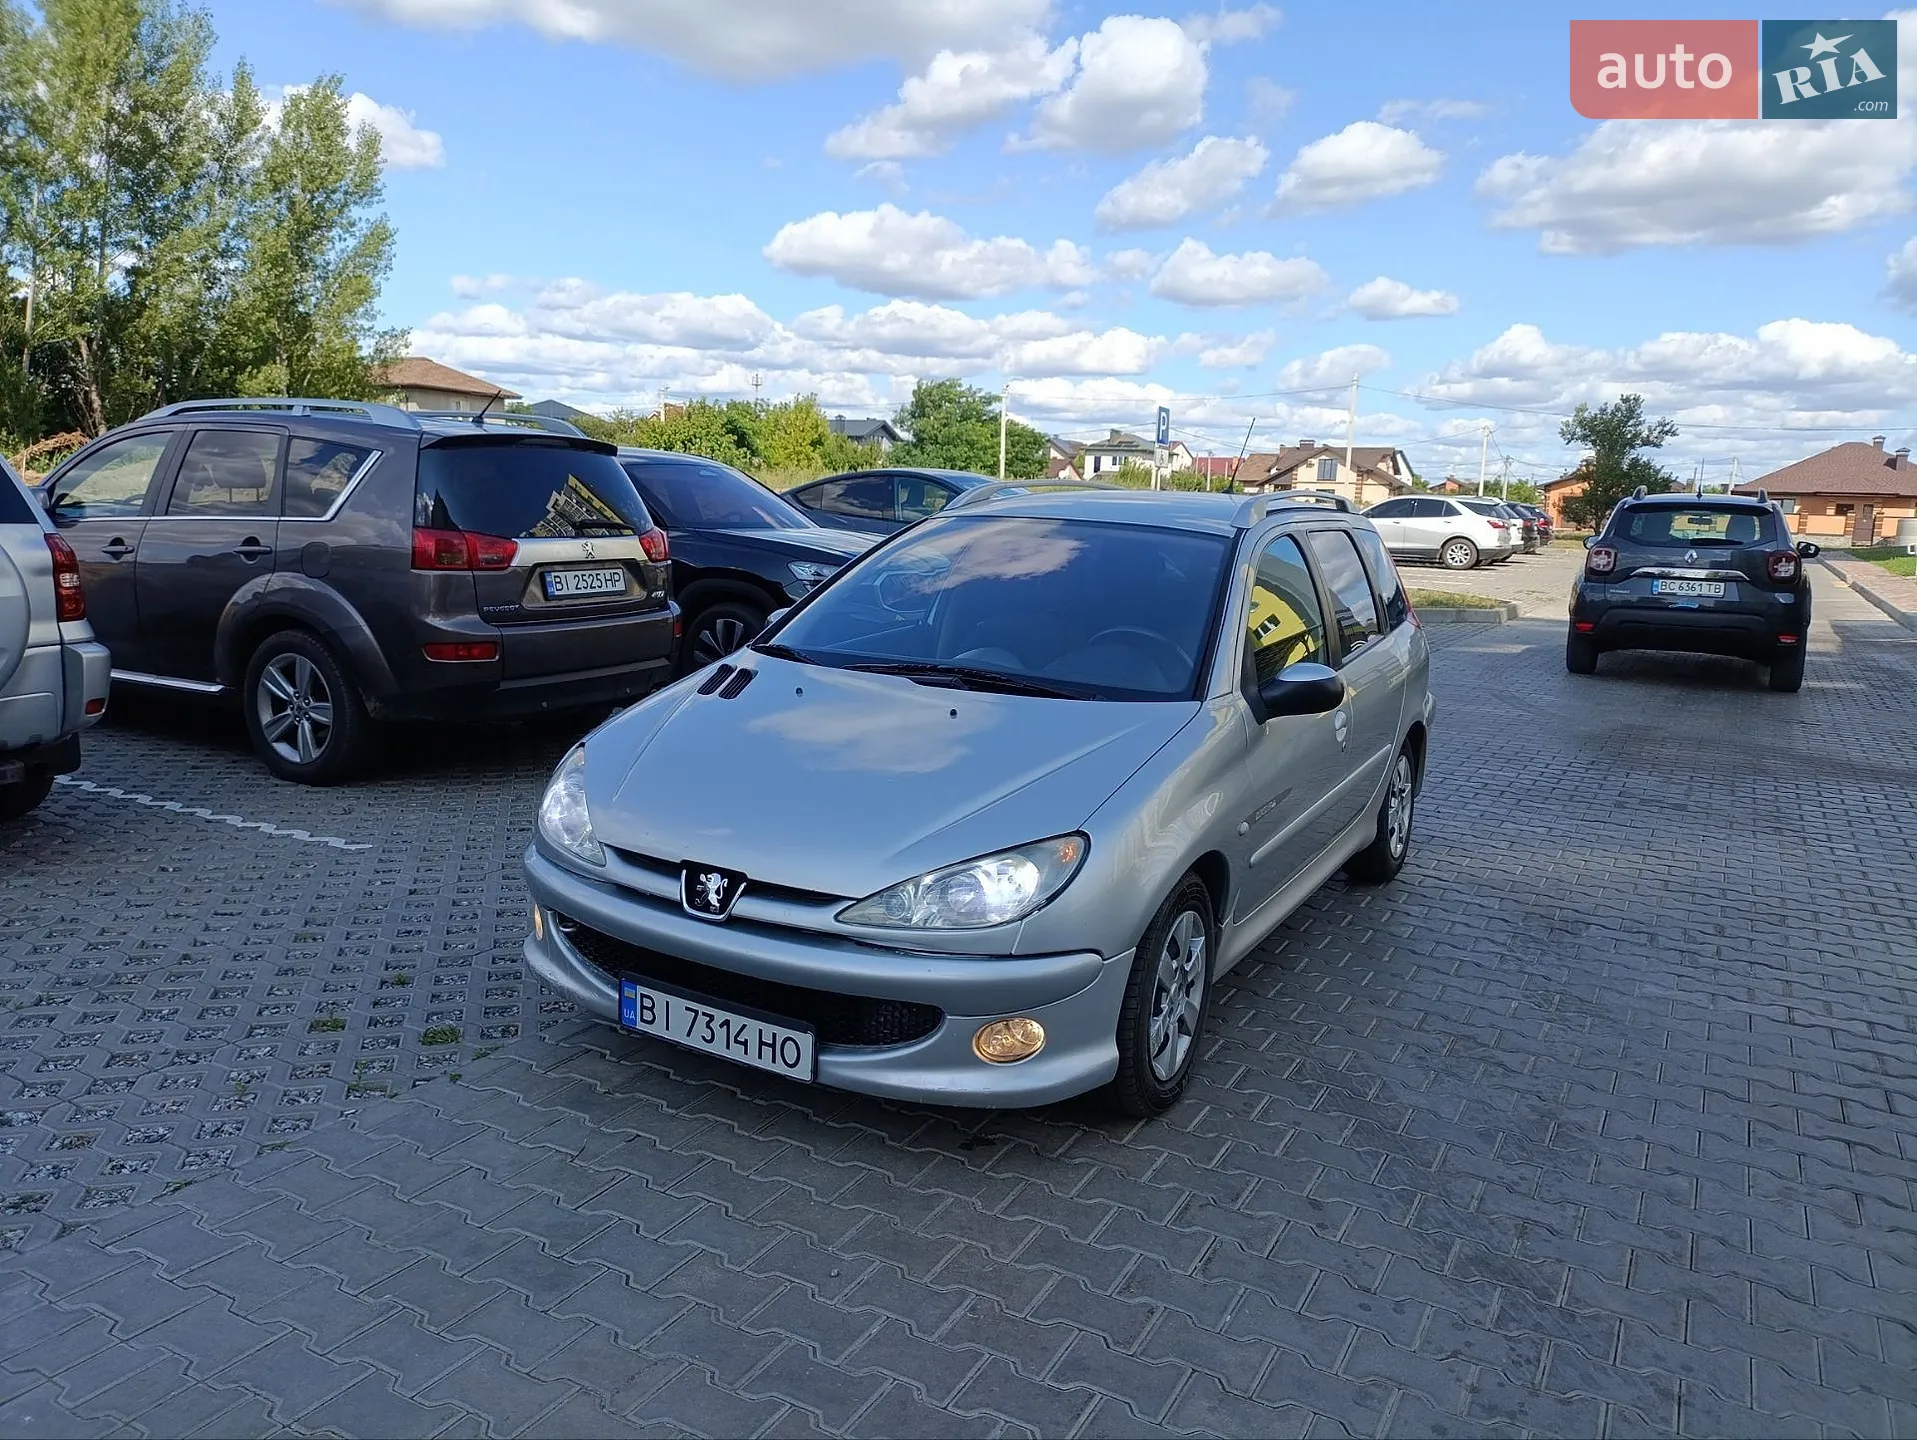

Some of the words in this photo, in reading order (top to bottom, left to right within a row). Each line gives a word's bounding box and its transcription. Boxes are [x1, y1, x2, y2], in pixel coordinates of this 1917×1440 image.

[1160, 411, 1168, 440] P
[554, 574, 570, 592] BI
[574, 573, 603, 590] 2525
[603, 572, 621, 588] HP
[1660, 581, 1677, 591] BC
[1678, 581, 1703, 592] 6361
[1707, 583, 1722, 593] TB
[623, 1008, 636, 1021] UA
[639, 992, 671, 1032] BI
[684, 1005, 749, 1056] 7314
[757, 1028, 801, 1069] HO
